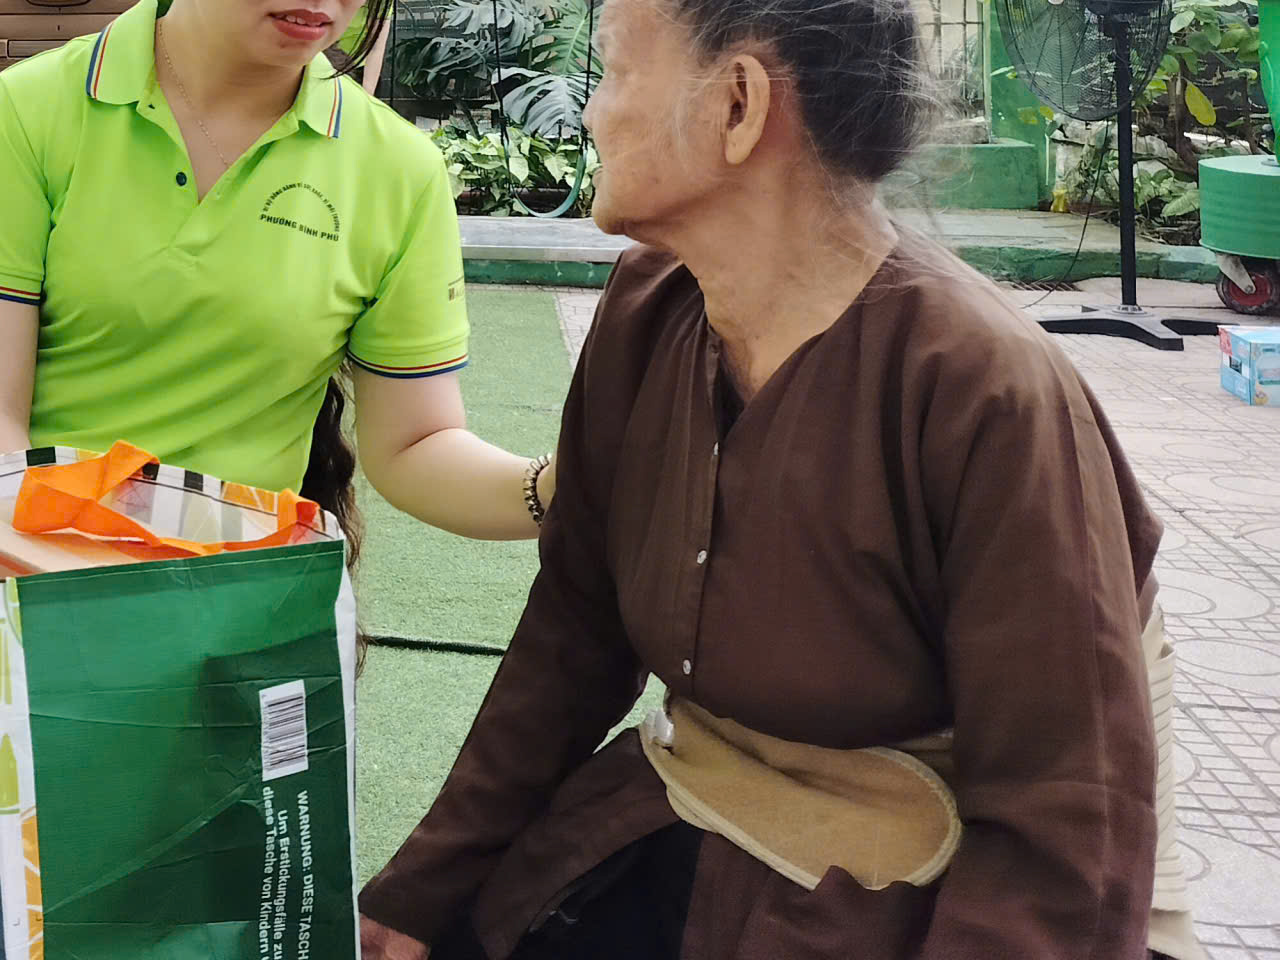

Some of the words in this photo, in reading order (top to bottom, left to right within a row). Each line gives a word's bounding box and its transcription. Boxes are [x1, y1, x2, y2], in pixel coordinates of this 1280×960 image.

[263, 786, 274, 825] diese
[277, 809, 288, 834] Um
[264, 826, 277, 874] Tasche
[297, 790, 313, 872] WARNUNG:
[261, 876, 272, 899] von
[273, 837, 291, 940] Erstickungsfälle
[301, 874, 314, 913] DIESE
[258, 902, 272, 953] Kindern
[273, 943, 283, 960] zu
